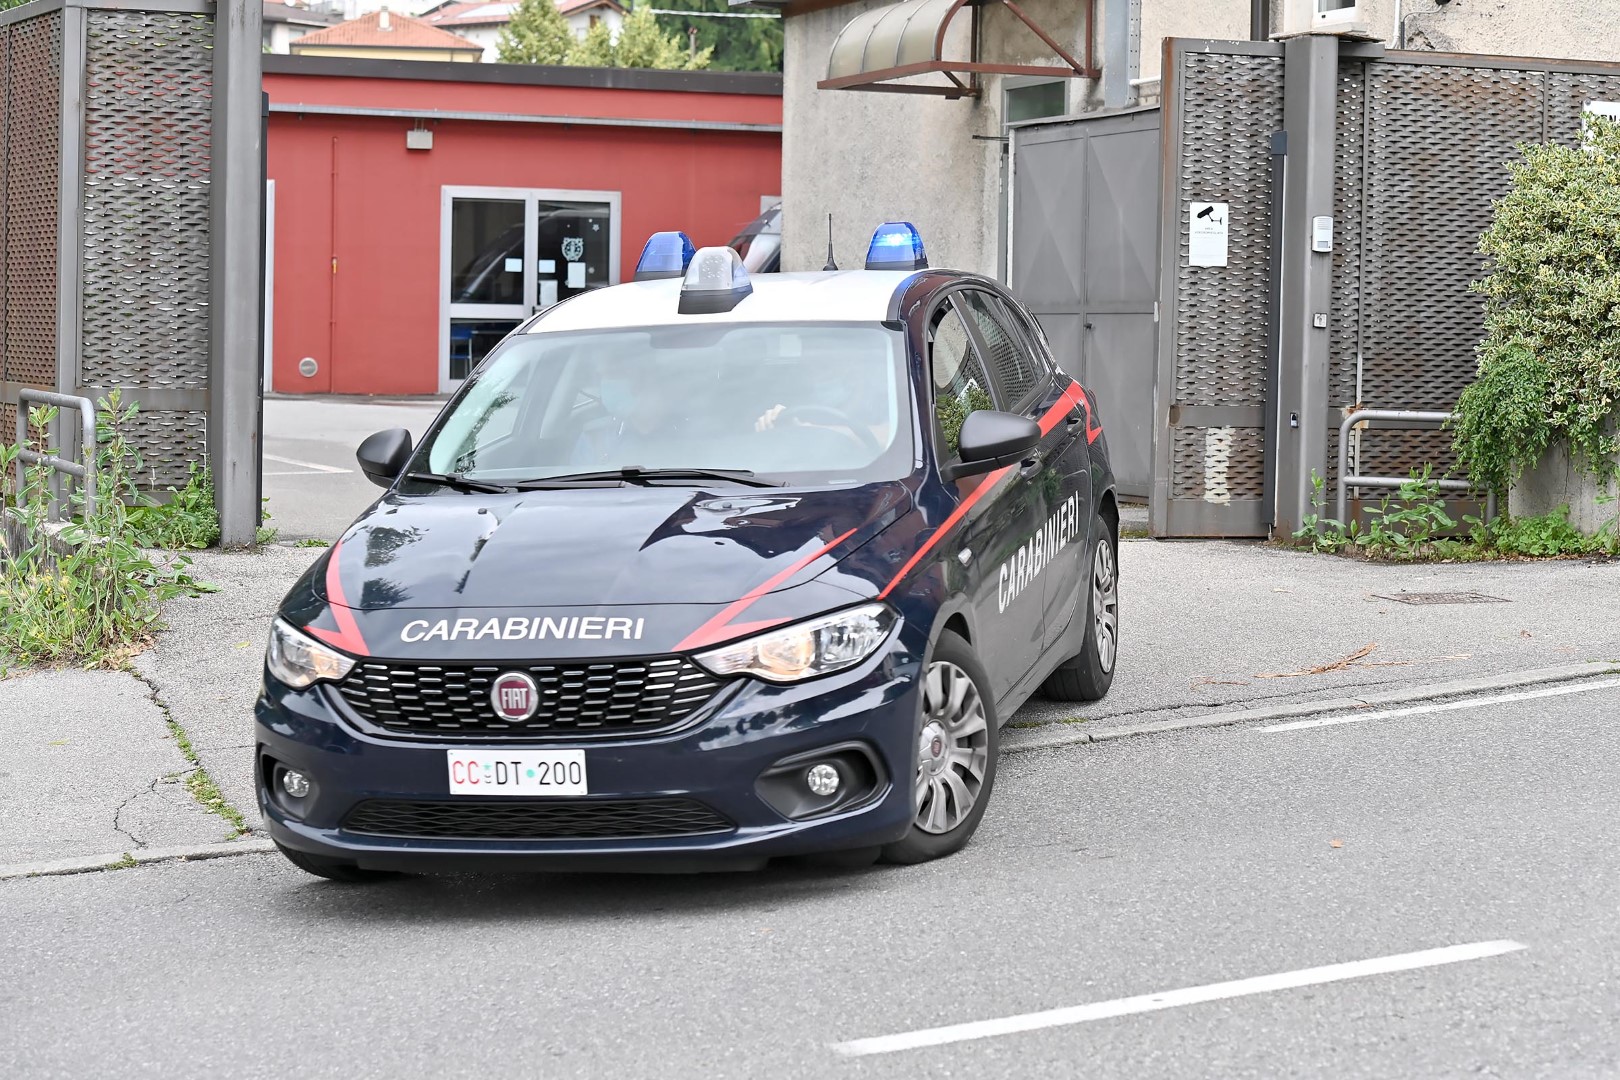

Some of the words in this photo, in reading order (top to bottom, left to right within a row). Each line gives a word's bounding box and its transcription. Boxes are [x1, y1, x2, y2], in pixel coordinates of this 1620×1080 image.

[998, 490, 1079, 614] CARABINIERI
[400, 617, 645, 643] CARABINIERI
[500, 688, 528, 709] FIAT
[452, 760, 480, 785] CC
[495, 761, 522, 785] DT
[538, 761, 581, 785] 200
